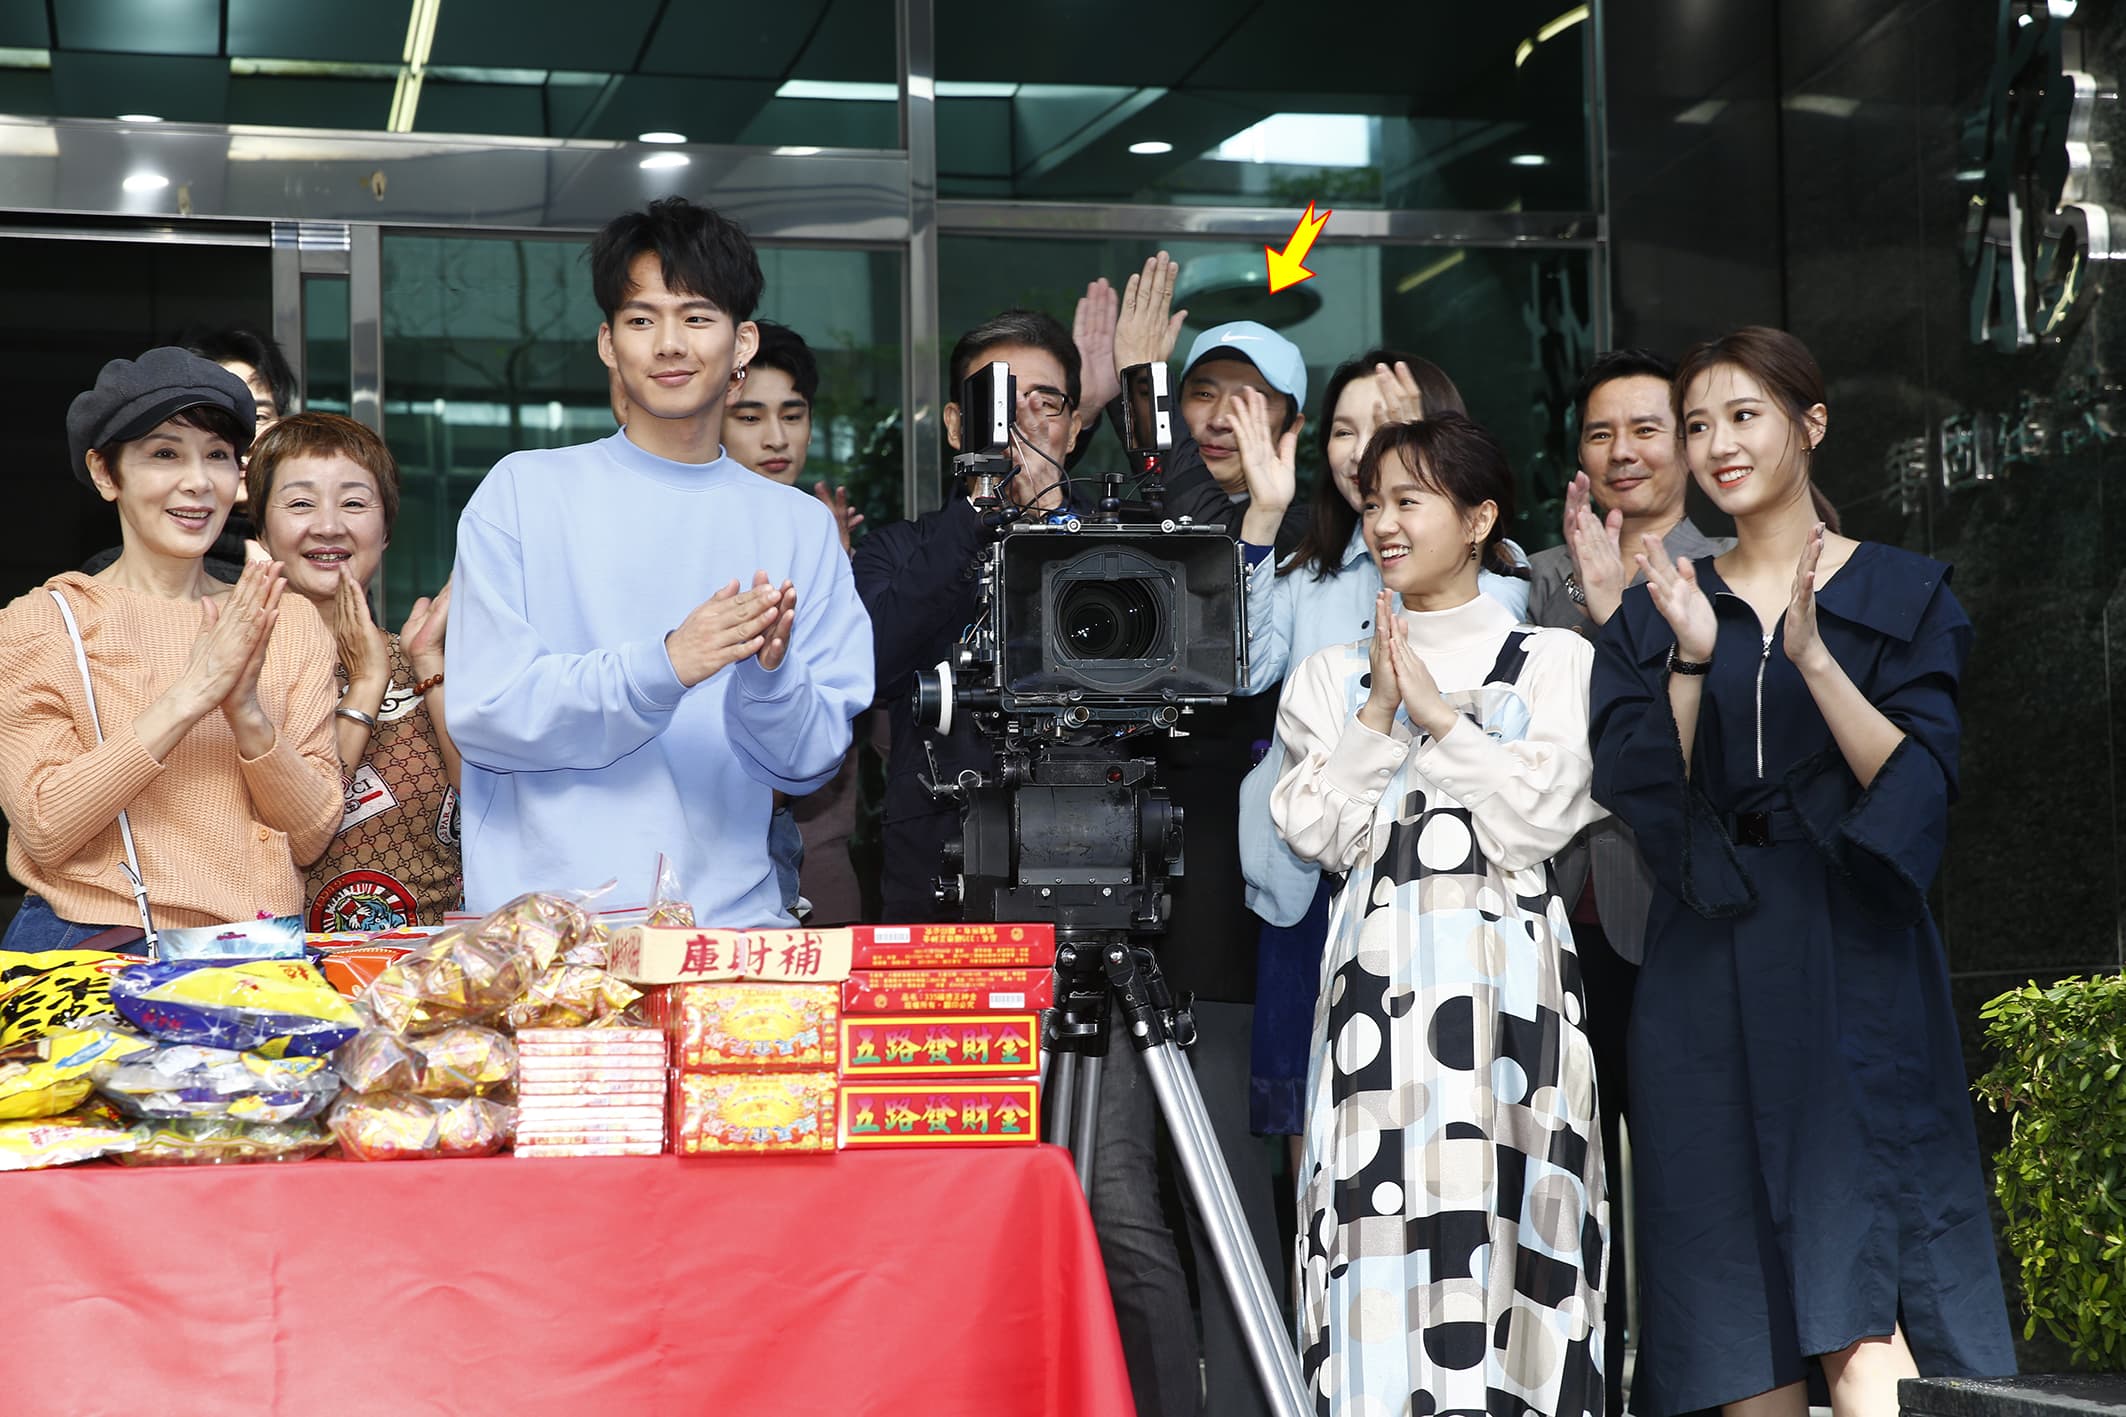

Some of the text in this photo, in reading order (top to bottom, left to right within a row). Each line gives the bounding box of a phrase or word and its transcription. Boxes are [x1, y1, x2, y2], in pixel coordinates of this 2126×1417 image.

[852, 1025, 1030, 1064] 五路發財金
[851, 1094, 1030, 1133] 五路發財金
